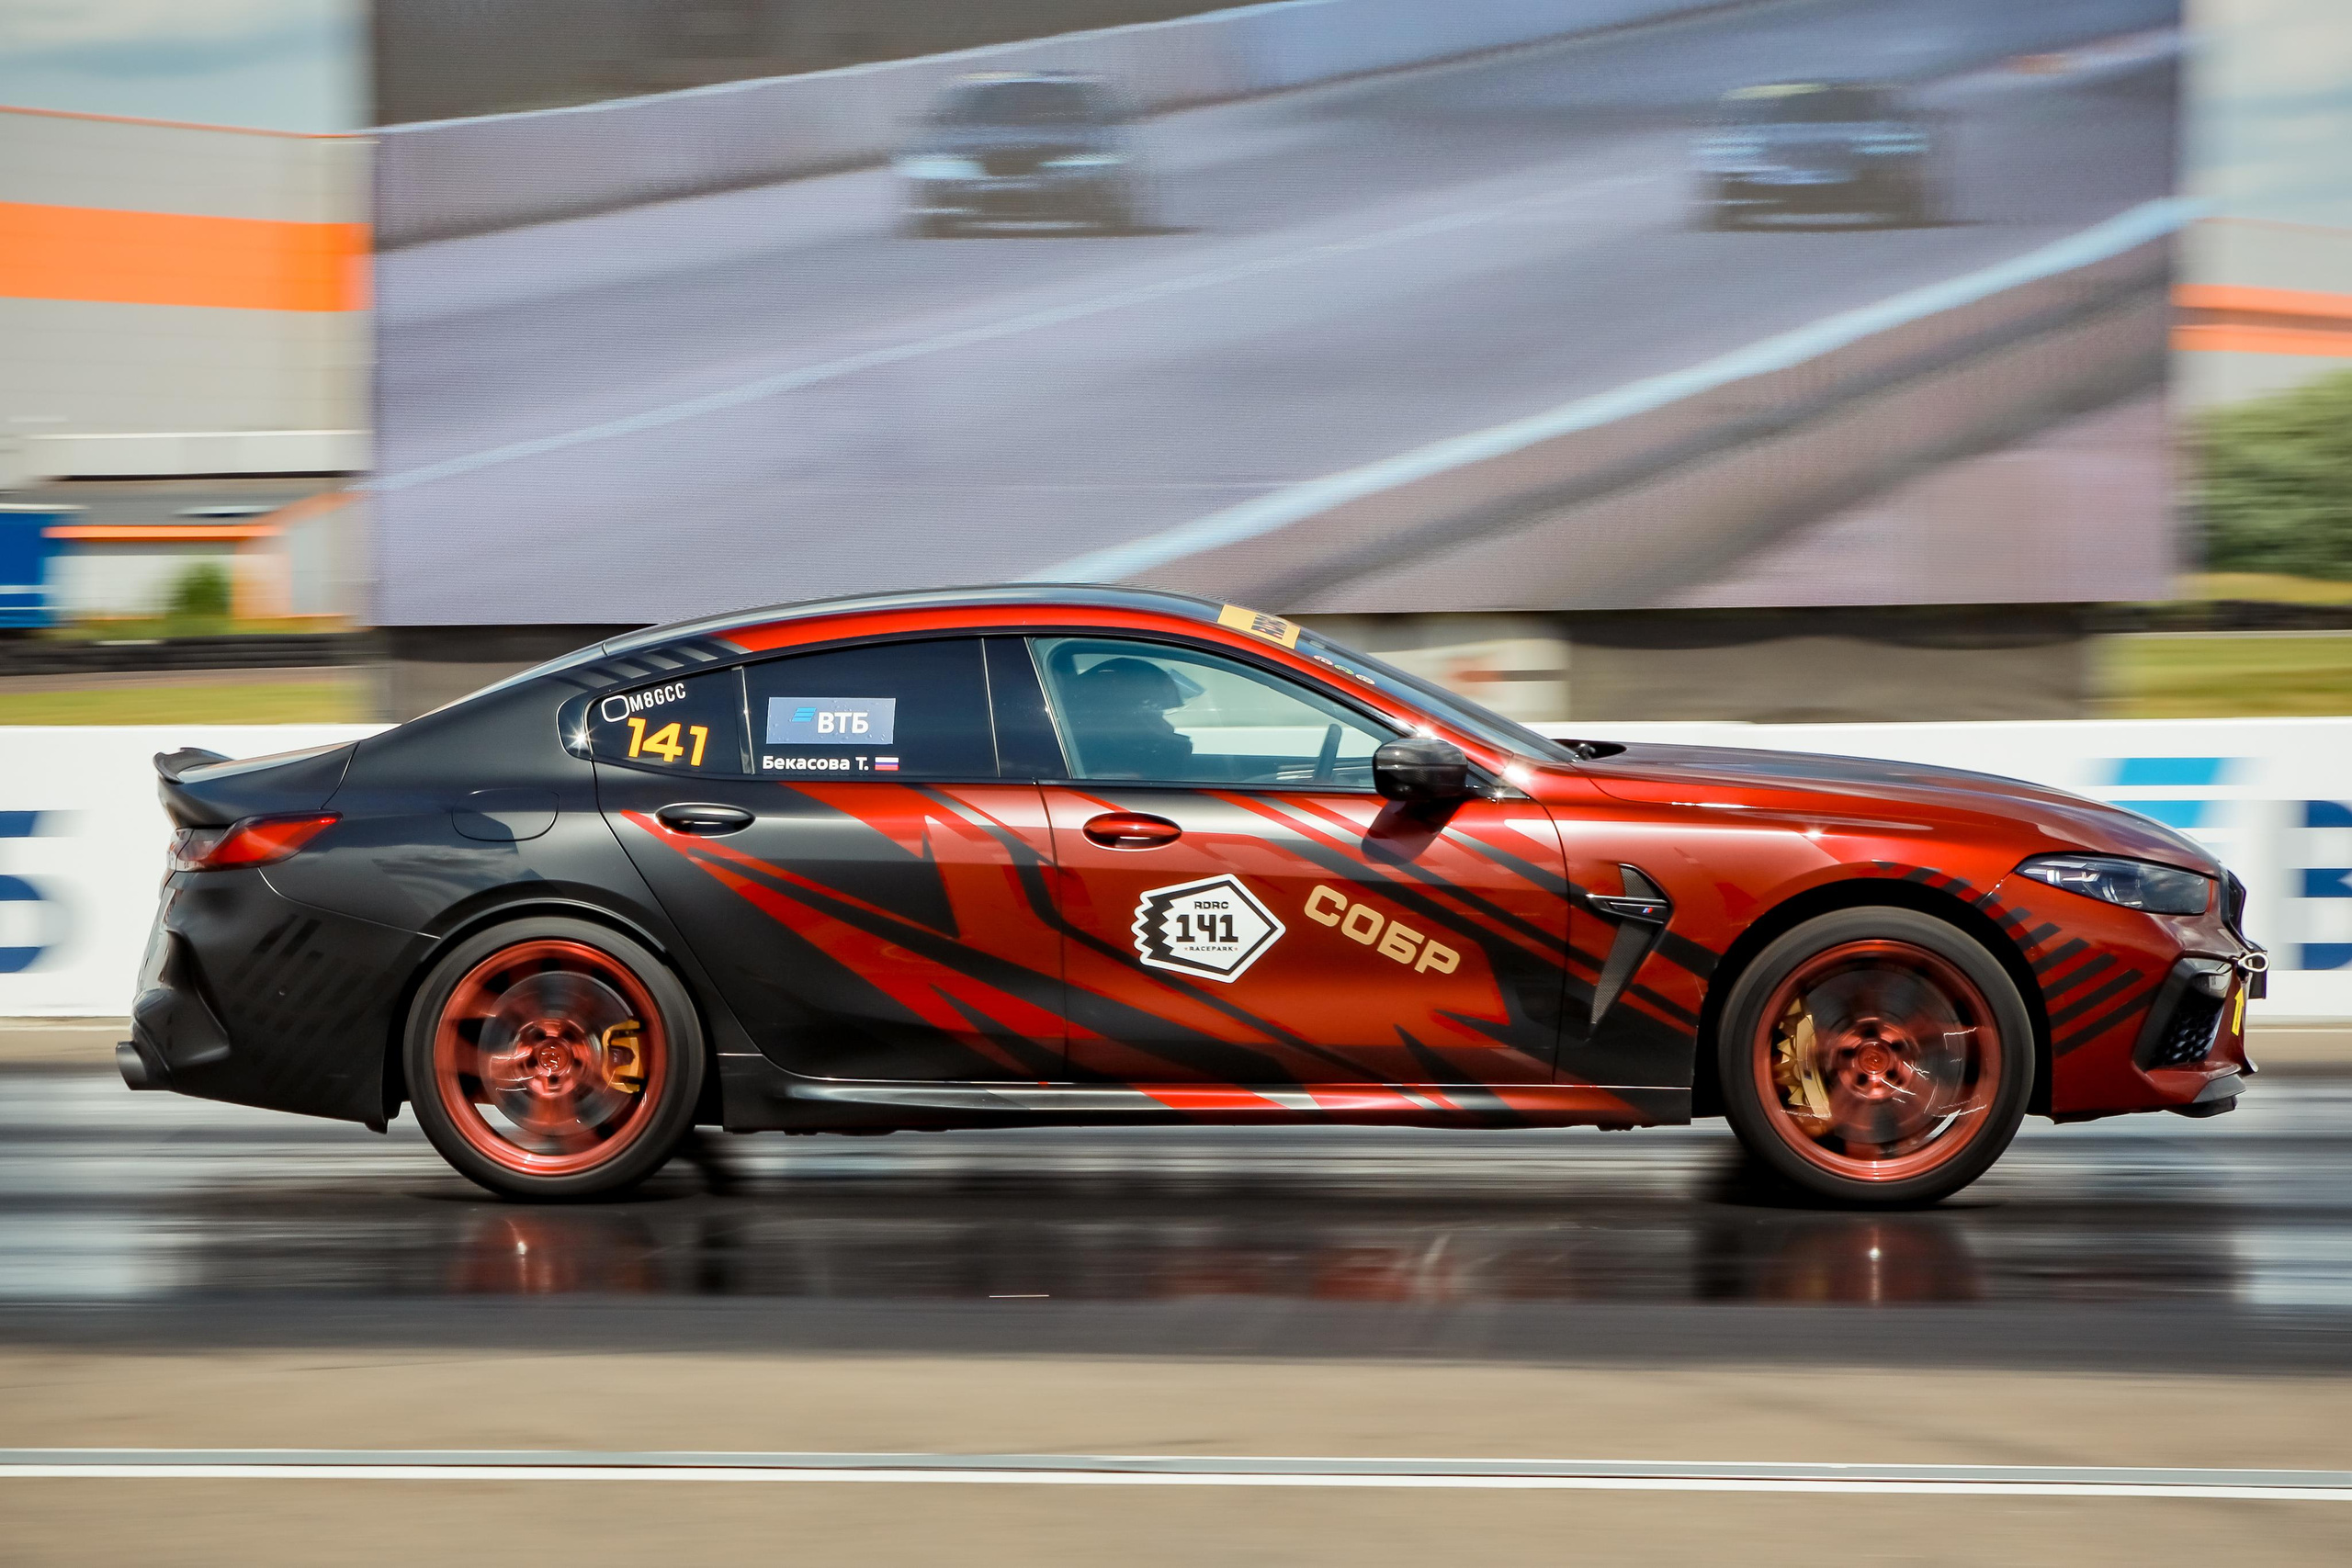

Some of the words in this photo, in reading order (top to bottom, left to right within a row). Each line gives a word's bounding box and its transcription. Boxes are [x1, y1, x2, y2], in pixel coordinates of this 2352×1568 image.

[628, 682, 686, 712] M8GCC
[817, 711, 869, 734] ВТБ
[627, 716, 708, 767] 141
[762, 755, 851, 771] Бекасова
[854, 756, 870, 772] Т.
[1194, 901, 1229, 909] RDRC
[1176, 914, 1238, 942] 141
[1304, 885, 1461, 975] СОБР
